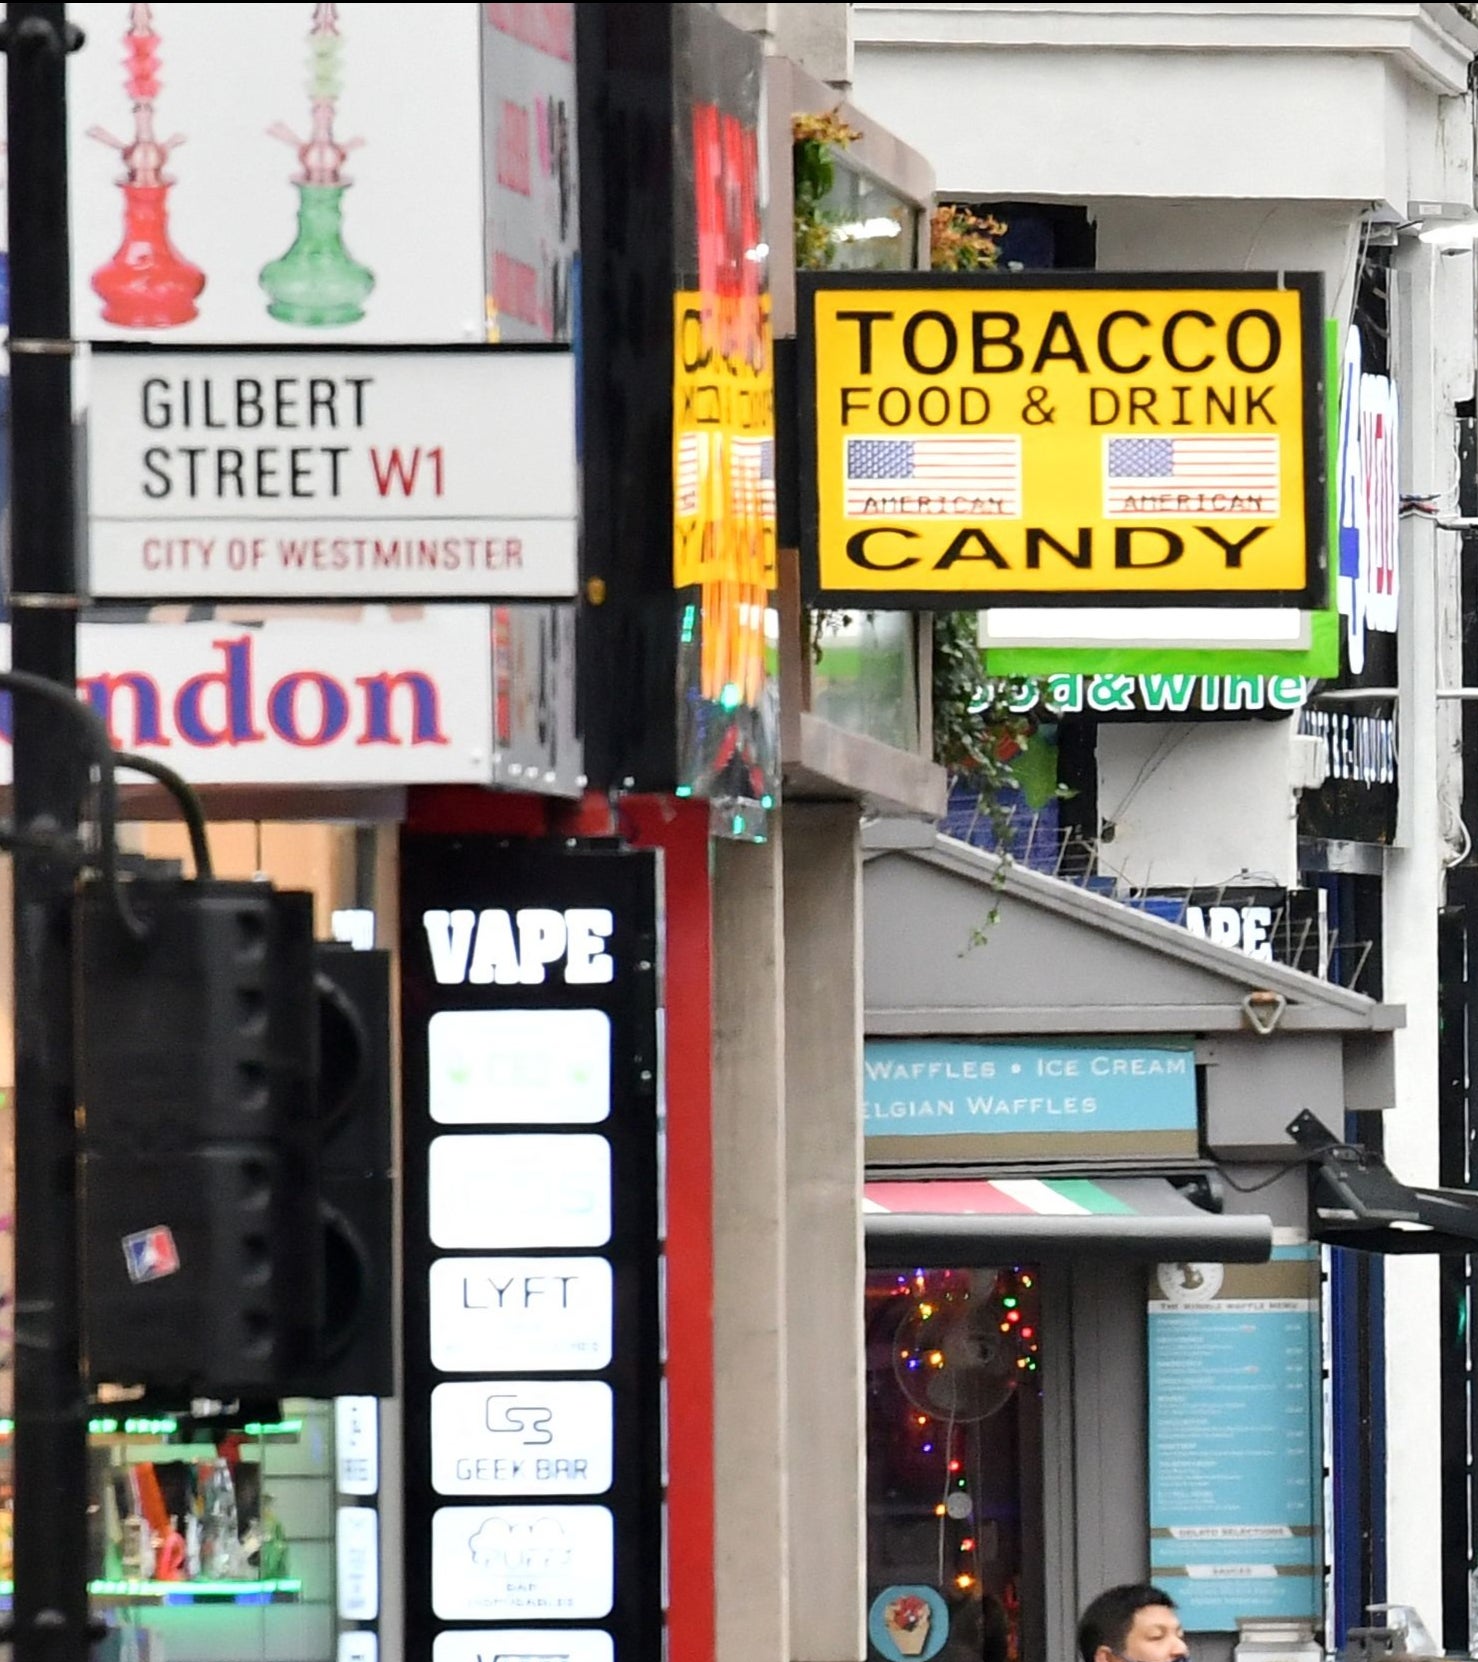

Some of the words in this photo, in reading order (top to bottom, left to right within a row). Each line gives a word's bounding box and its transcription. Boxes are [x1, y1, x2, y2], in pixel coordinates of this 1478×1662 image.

[836, 308, 1282, 375] TOBACCO
[141, 378, 375, 430] GILBERT
[840, 386, 991, 426] FOOD
[1021, 386, 1056, 425] &
[1090, 386, 1278, 426] DRINK
[142, 447, 350, 499] STREET
[370, 447, 447, 497] W1
[862, 496, 1004, 515] AMERICAN
[1121, 493, 1263, 512] AMERICAN
[142, 537, 215, 571] CITY
[227, 537, 271, 571] OF
[279, 537, 525, 571] WESTMINSTER
[845, 526, 1272, 571] CANDY
[80, 635, 450, 748] ndon
[423, 908, 613, 985] VAPE
[865, 1059, 996, 1081] WAFFLES
[1037, 1058, 1079, 1077] ICE
[1091, 1056, 1187, 1076] CREAM
[967, 1096, 1098, 1115] WAFFLES
[462, 1276, 580, 1309] LYFT
[456, 1458, 526, 1481] GEEK
[536, 1458, 589, 1481] BAR
